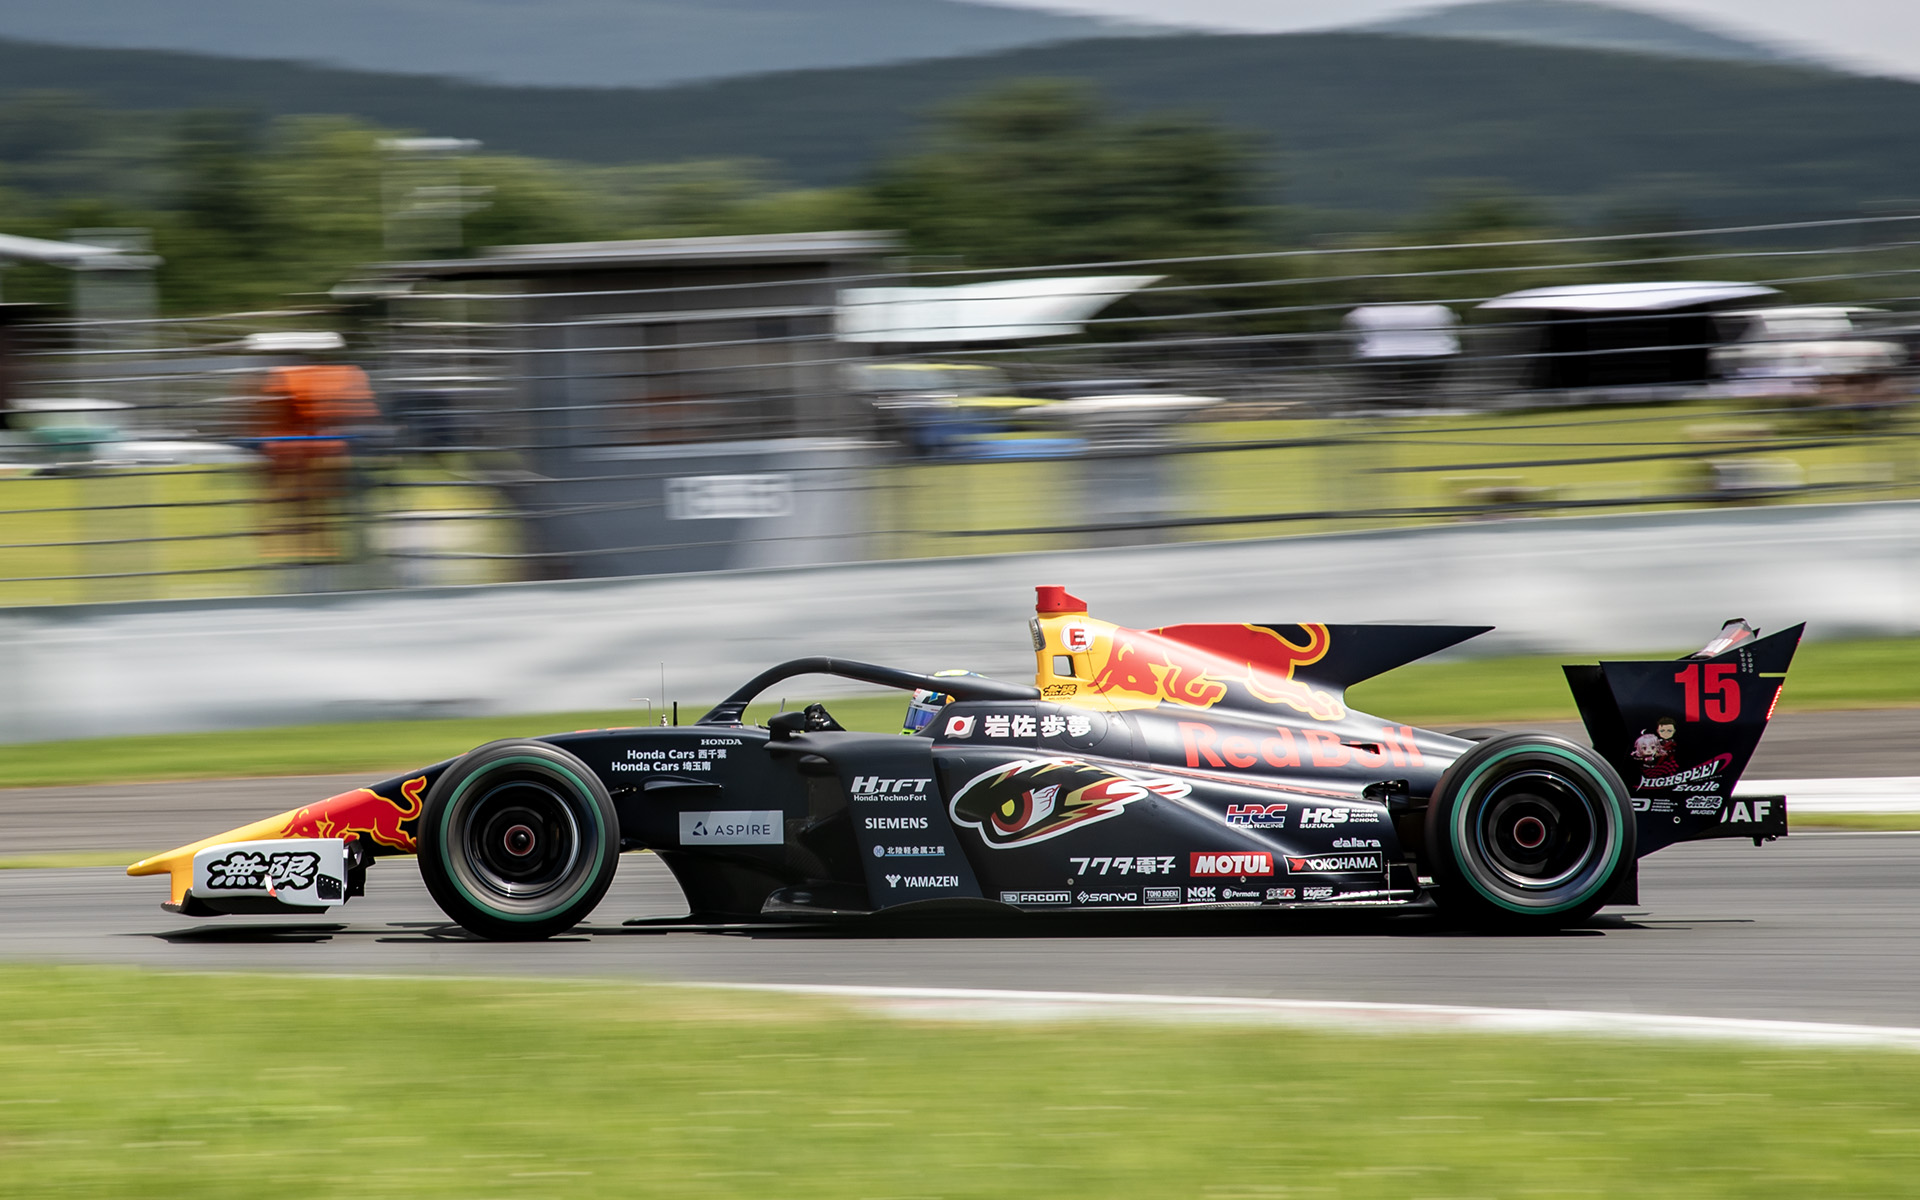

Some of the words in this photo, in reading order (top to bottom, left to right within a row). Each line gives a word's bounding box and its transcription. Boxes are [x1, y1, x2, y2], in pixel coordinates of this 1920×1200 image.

[1069, 628, 1087, 646] E
[1674, 663, 1741, 723] 15
[984, 714, 1092, 738] 岩佐歩夢
[700, 738, 742, 746] HONDA
[1178, 722, 1301, 768] Red
[627, 749, 666, 760] Honda
[668, 749, 695, 760] Cars
[697, 749, 727, 759] 西千葉
[611, 761, 650, 772] Honda
[653, 761, 679, 772] Cars
[682, 761, 712, 772] 埼玉南
[850, 776, 932, 795] HTFT
[1672, 780, 1721, 792] Etoile
[853, 794, 879, 802] Honda
[1225, 803, 1288, 824] HRC
[1300, 807, 1350, 824] HRS
[1720, 801, 1772, 823] AF
[865, 817, 929, 829] SIEMENS
[714, 824, 771, 836] ASPIRE
[1069, 856, 1177, 876] フクダ電子
[1195, 855, 1271, 874] MOTUL
[1306, 857, 1379, 871] YOKOHAMA
[903, 876, 959, 888] YAMAZEN
[1020, 893, 1069, 902] FACOM
[1088, 893, 1138, 902] SANYO
[1187, 886, 1217, 898] NGK
[1232, 890, 1260, 898] Permatex
